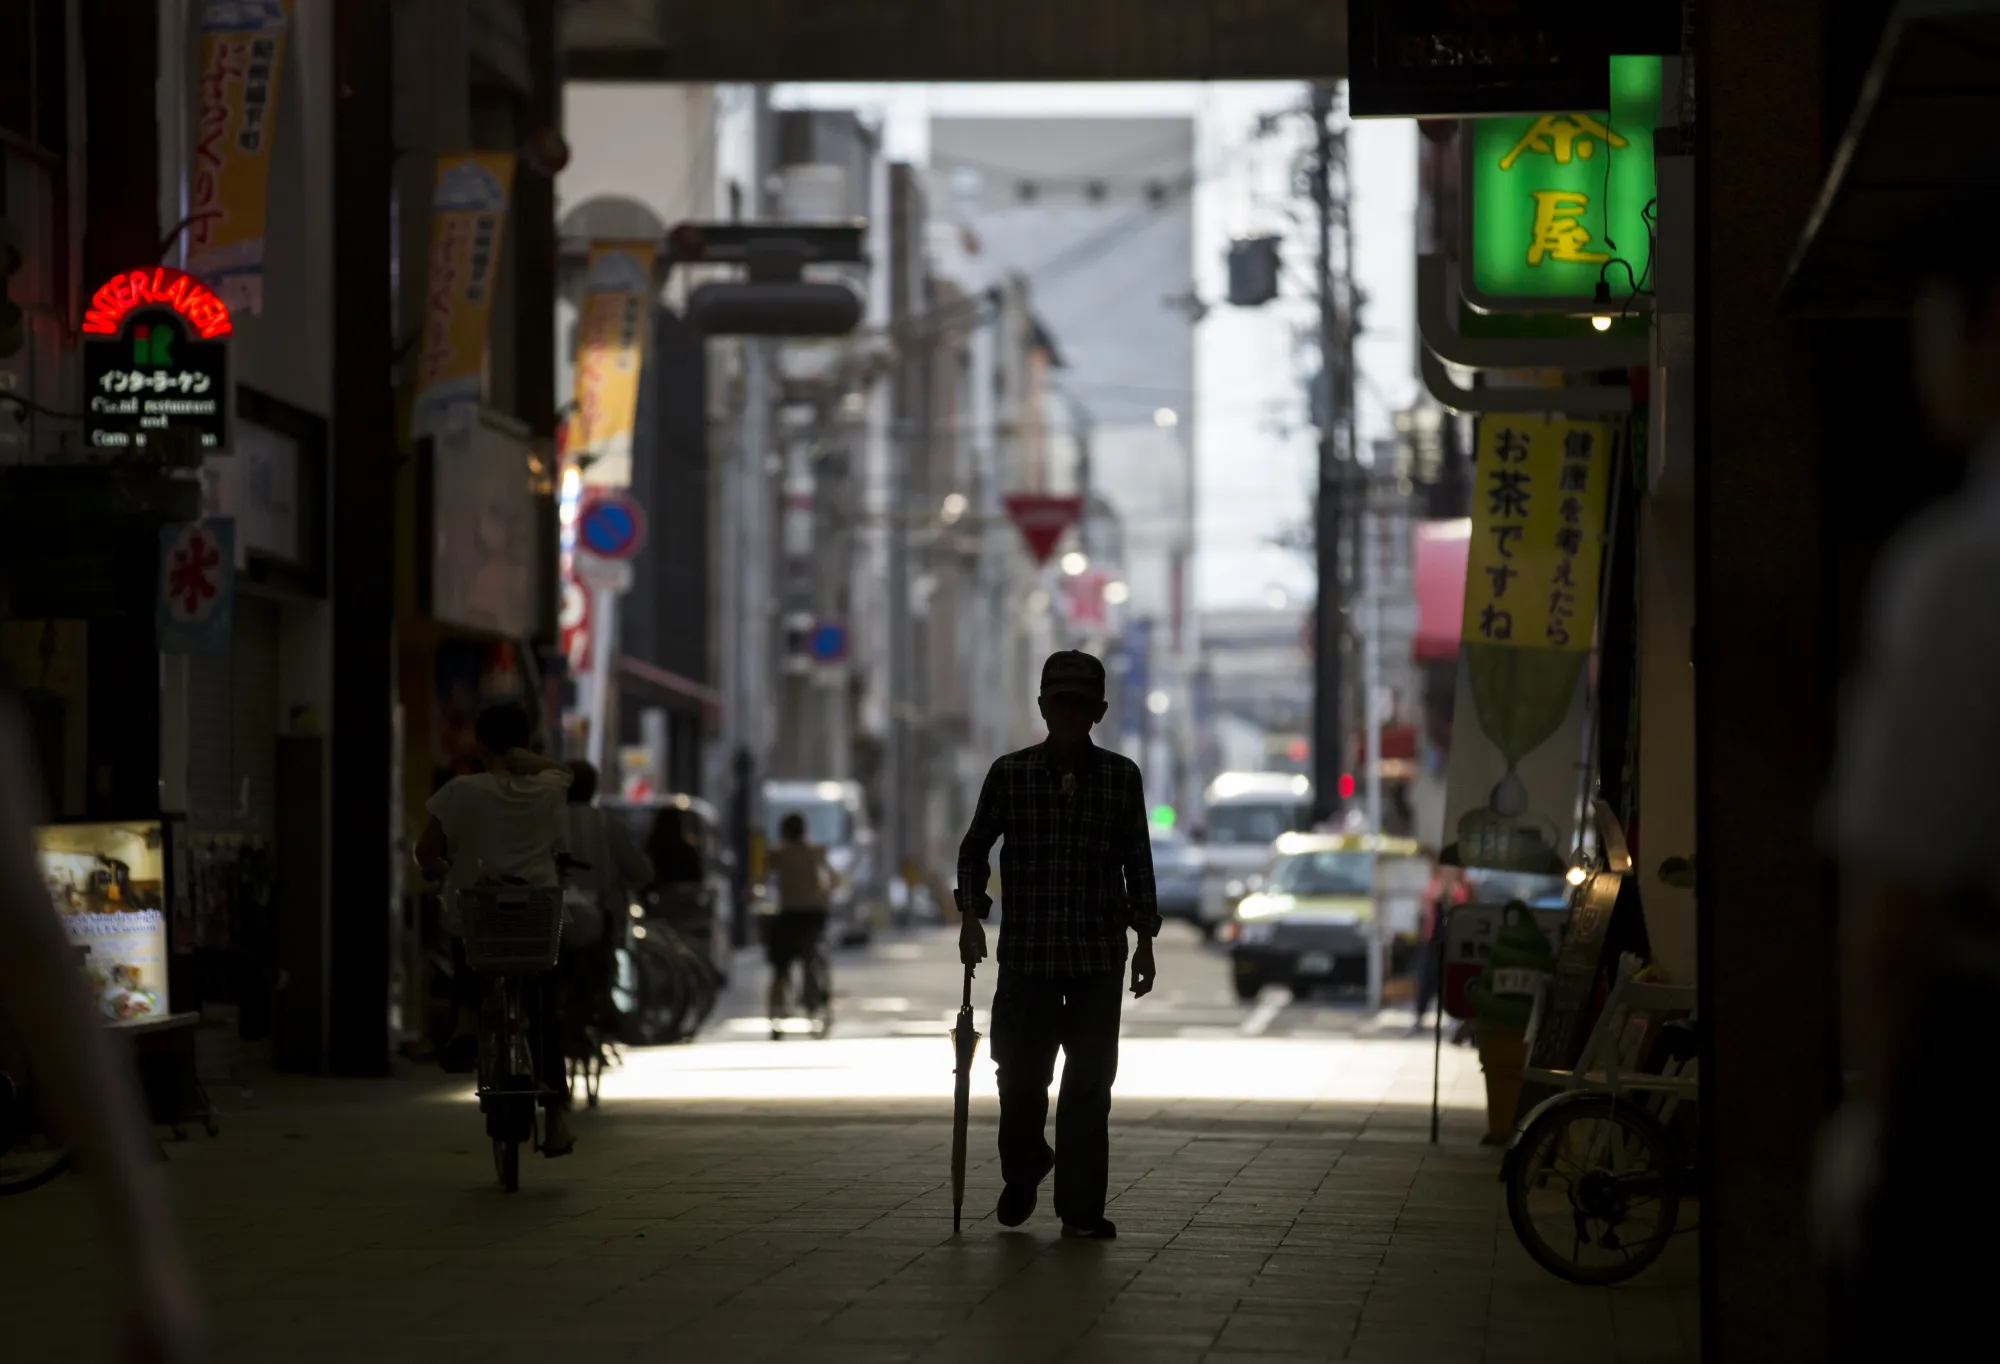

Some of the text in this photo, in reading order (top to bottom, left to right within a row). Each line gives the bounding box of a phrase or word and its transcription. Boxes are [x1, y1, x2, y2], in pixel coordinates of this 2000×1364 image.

[82, 268, 232, 338] INTERLAKEN
[99, 370, 211, 393] インターラーケン
[140, 415, 168, 428] and
[1480, 428, 1531, 638] お茶ですね
[1547, 430, 1593, 645] 健康を考えたら
[169, 533, 220, 614] 氷
